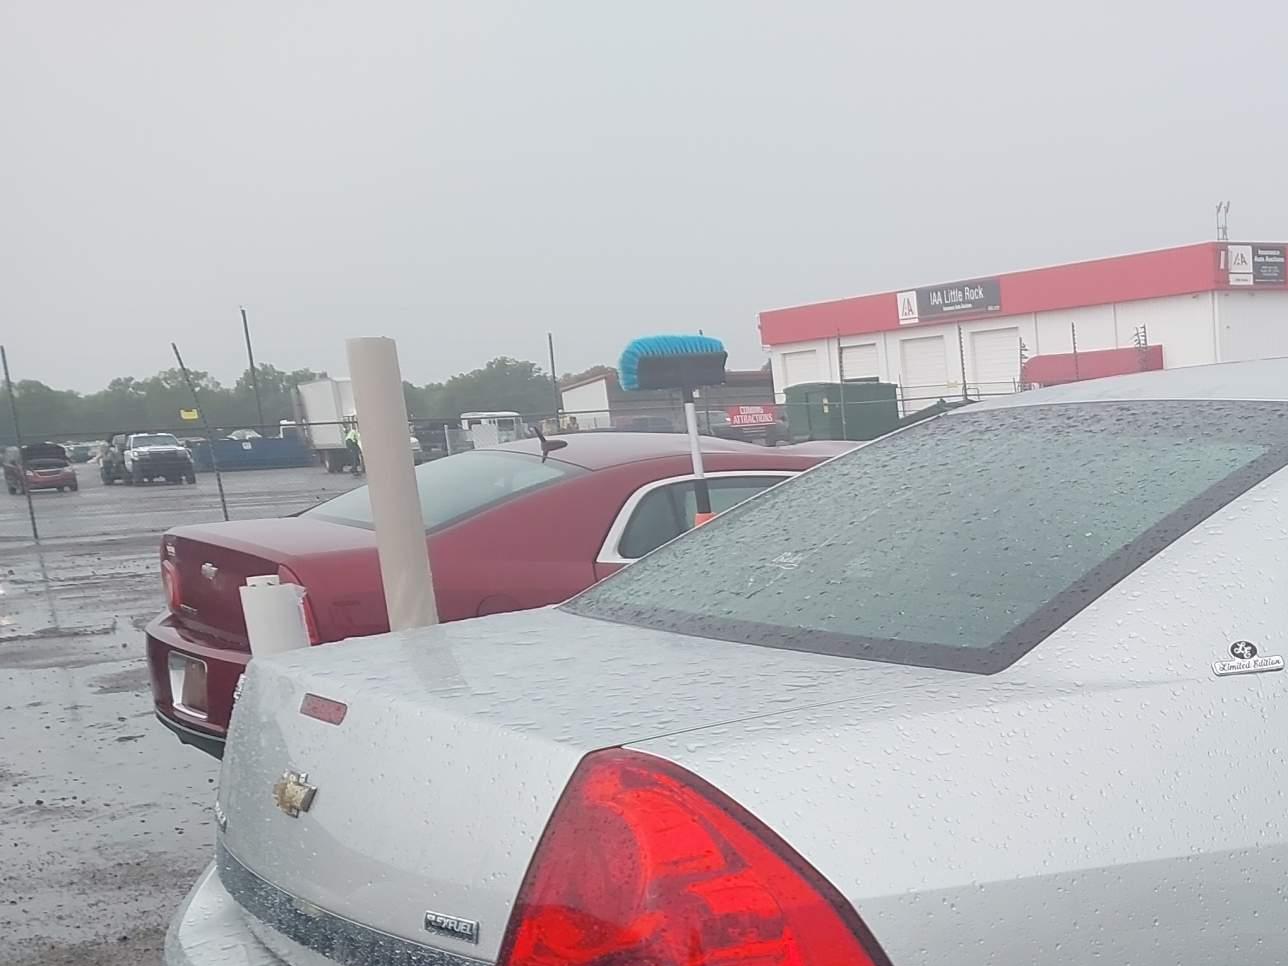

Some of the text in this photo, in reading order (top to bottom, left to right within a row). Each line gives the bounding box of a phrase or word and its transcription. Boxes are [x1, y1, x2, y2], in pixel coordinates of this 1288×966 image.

[943, 288, 963, 304] Little
[964, 285, 984, 300] Rock
[733, 413, 773, 424] ATTRACTIONS
[1219, 658, 1281, 672] Limited Edition
